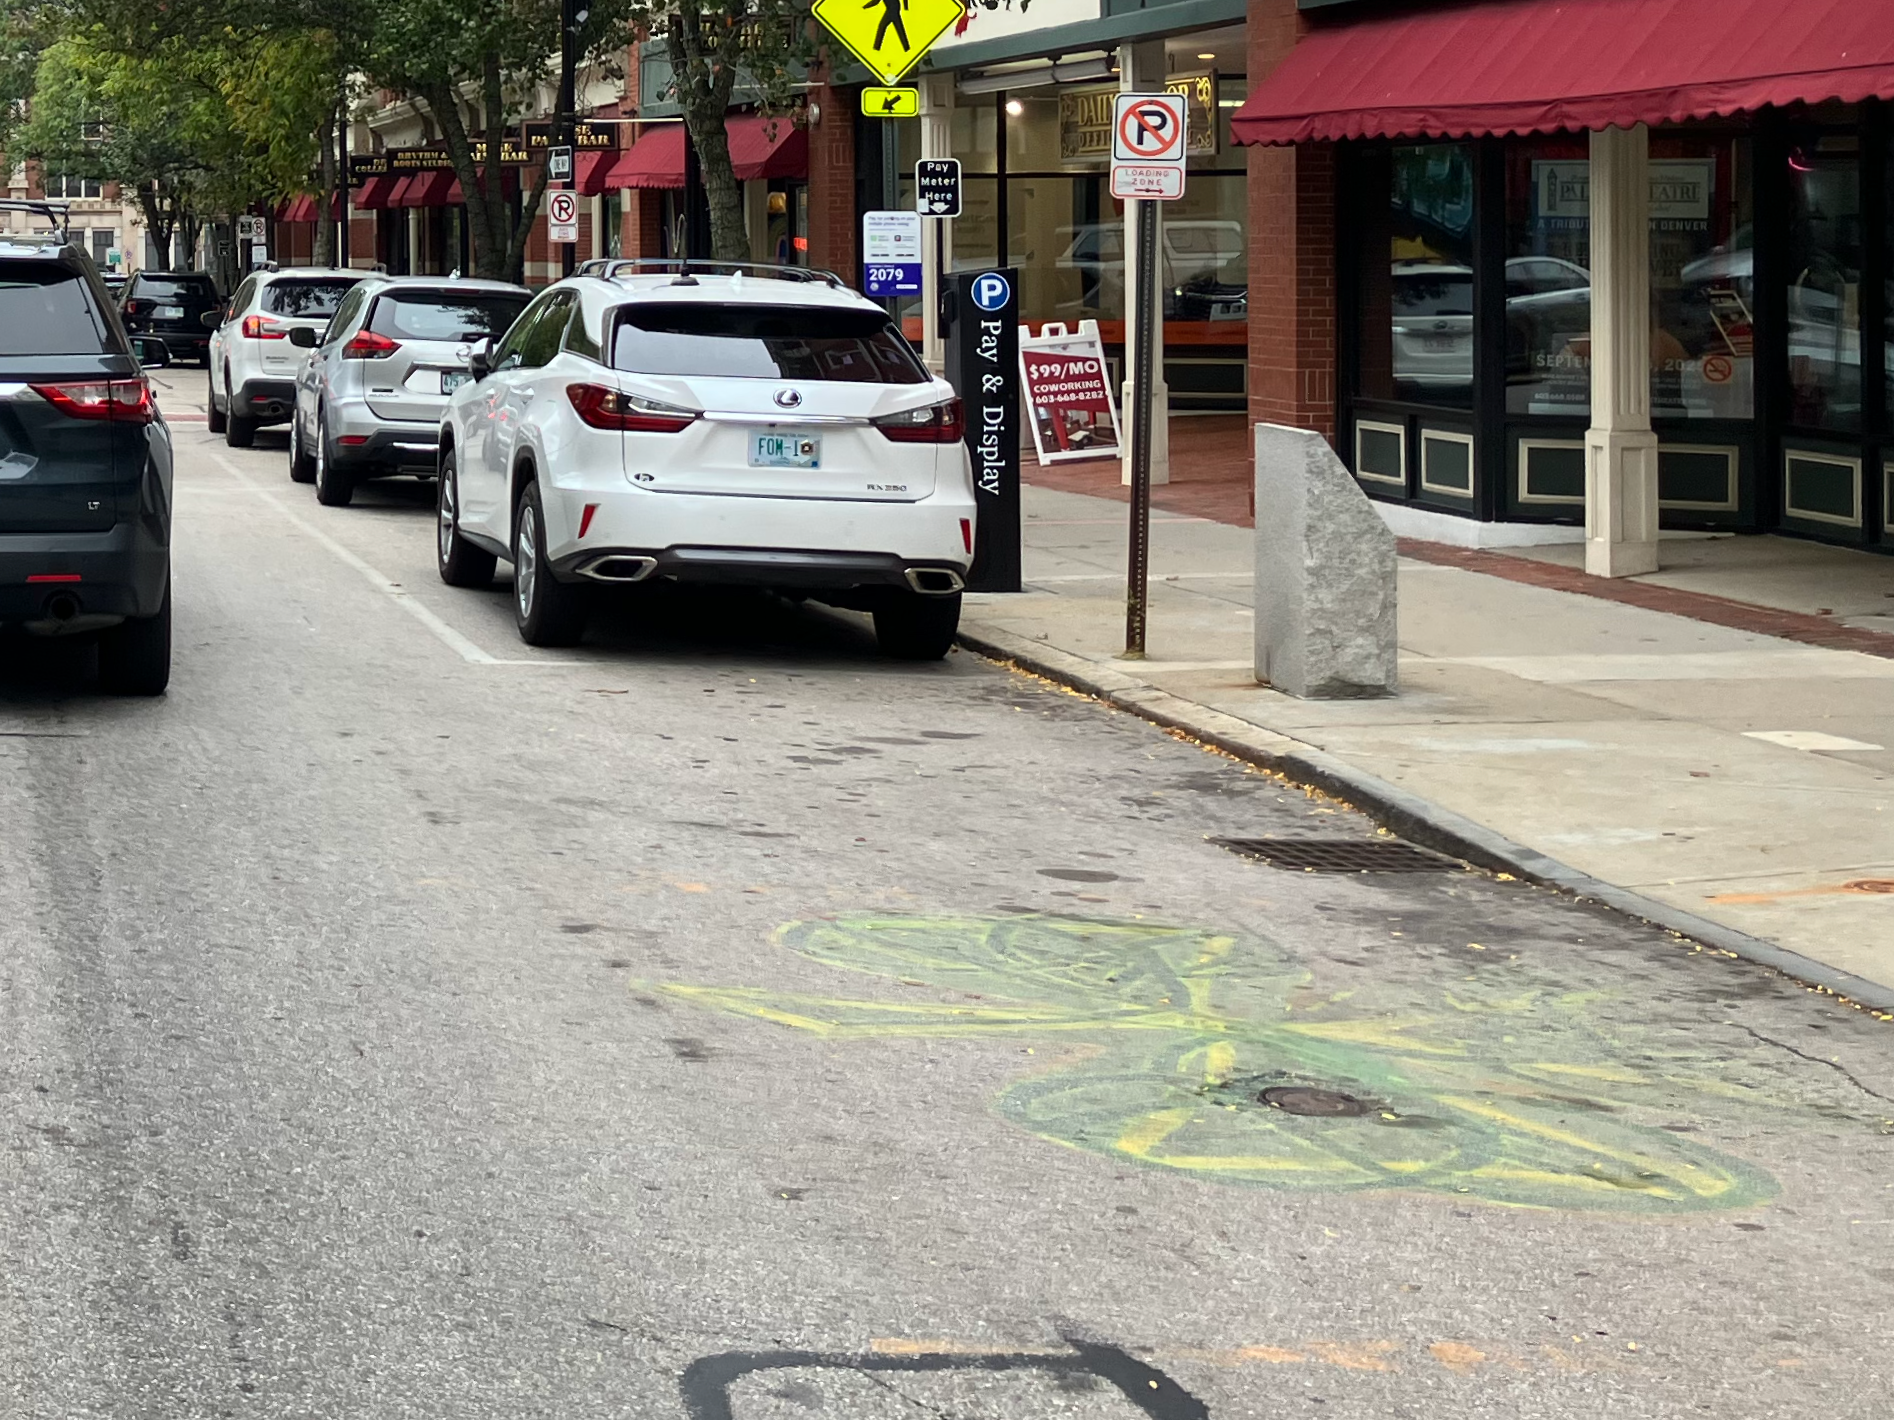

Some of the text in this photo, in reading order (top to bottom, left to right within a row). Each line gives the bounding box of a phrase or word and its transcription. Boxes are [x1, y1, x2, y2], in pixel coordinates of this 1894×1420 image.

[927, 162, 948, 172] Pay
[1125, 169, 1170, 177] LOADING
[921, 177, 956, 186] Meter
[1131, 178, 1163, 186] ZONE
[925, 191, 953, 200] Here
[1560, 182, 1700, 199] PAL EATRE
[1550, 220, 1590, 229] TRIBUT
[1661, 220, 1708, 230] DENVER
[869, 269, 904, 281] 2079
[1029, 360, 1099, 380] $99/MO
[1033, 380, 1101, 393] COWORKING
[1035, 390, 1104, 404] 603-668-8282
[976, 320, 1005, 495] Pay & Display
[87, 501, 101, 510] LT
